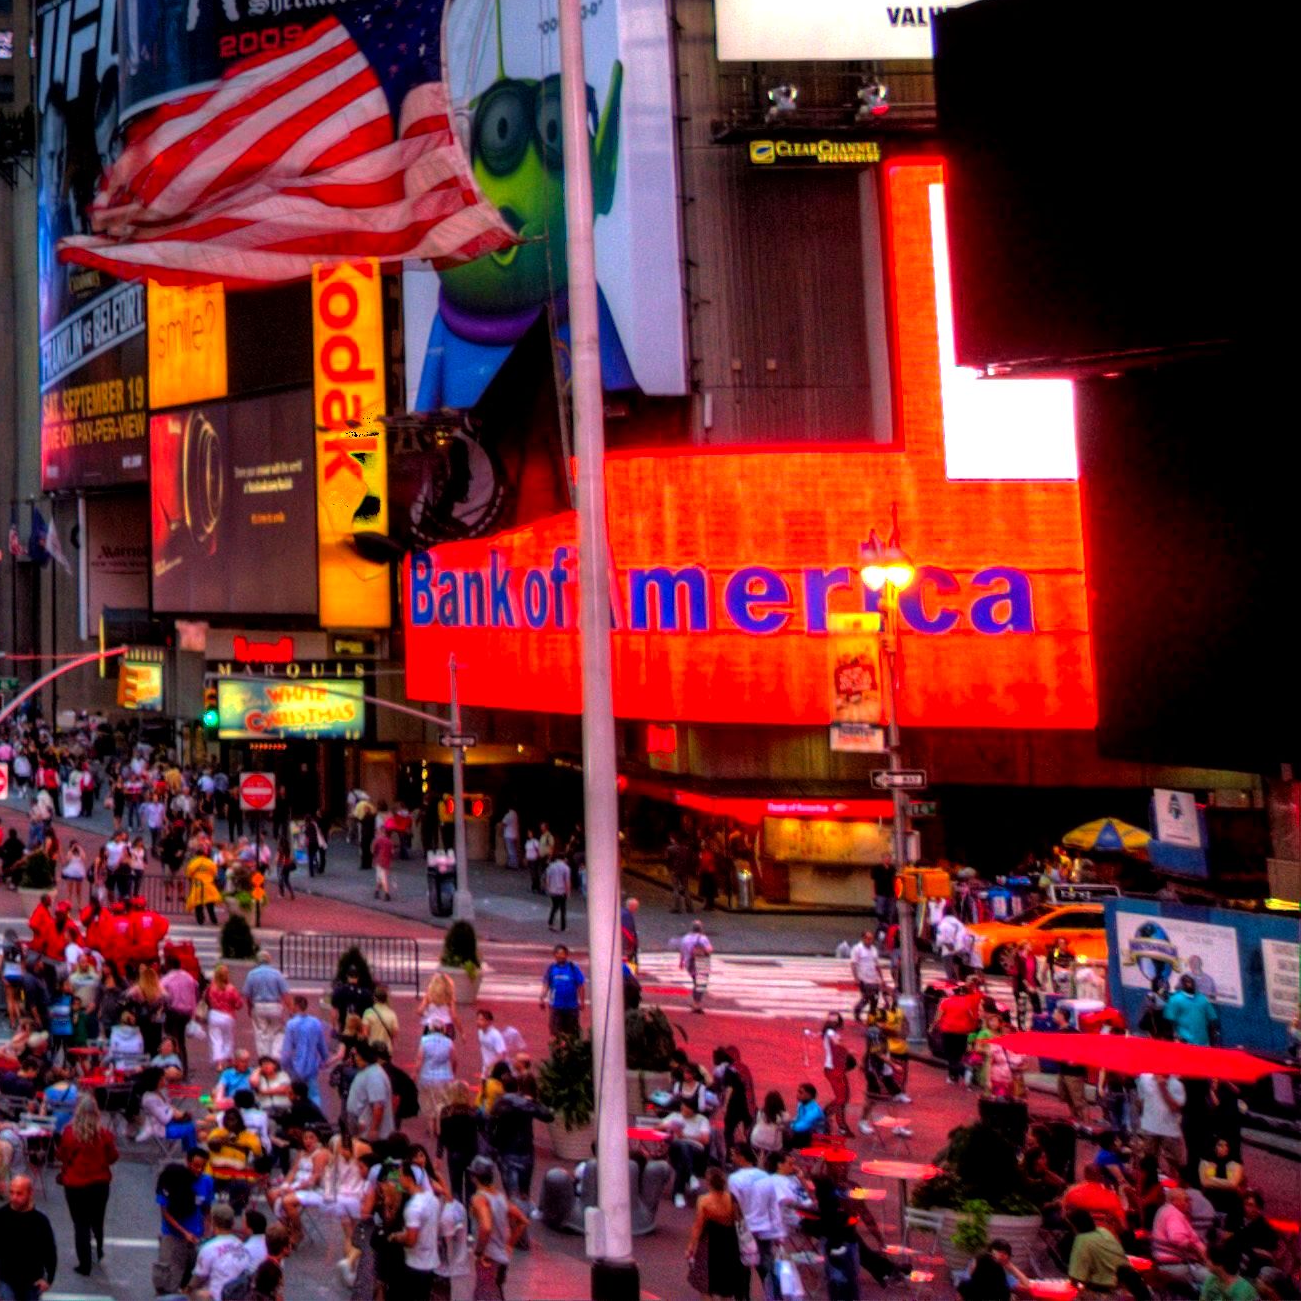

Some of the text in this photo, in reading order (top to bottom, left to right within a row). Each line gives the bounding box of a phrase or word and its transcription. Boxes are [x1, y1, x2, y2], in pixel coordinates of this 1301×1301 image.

[93, 286, 144, 346] BELFORT
[62, 375, 145, 421] SEPTEMBER 19
[75, 412, 146, 446] PAY-PER-VIEW
[409, 551, 512, 629] Bank
[523, 546, 569, 629] of
[217, 662, 366, 677] MARQUIS
